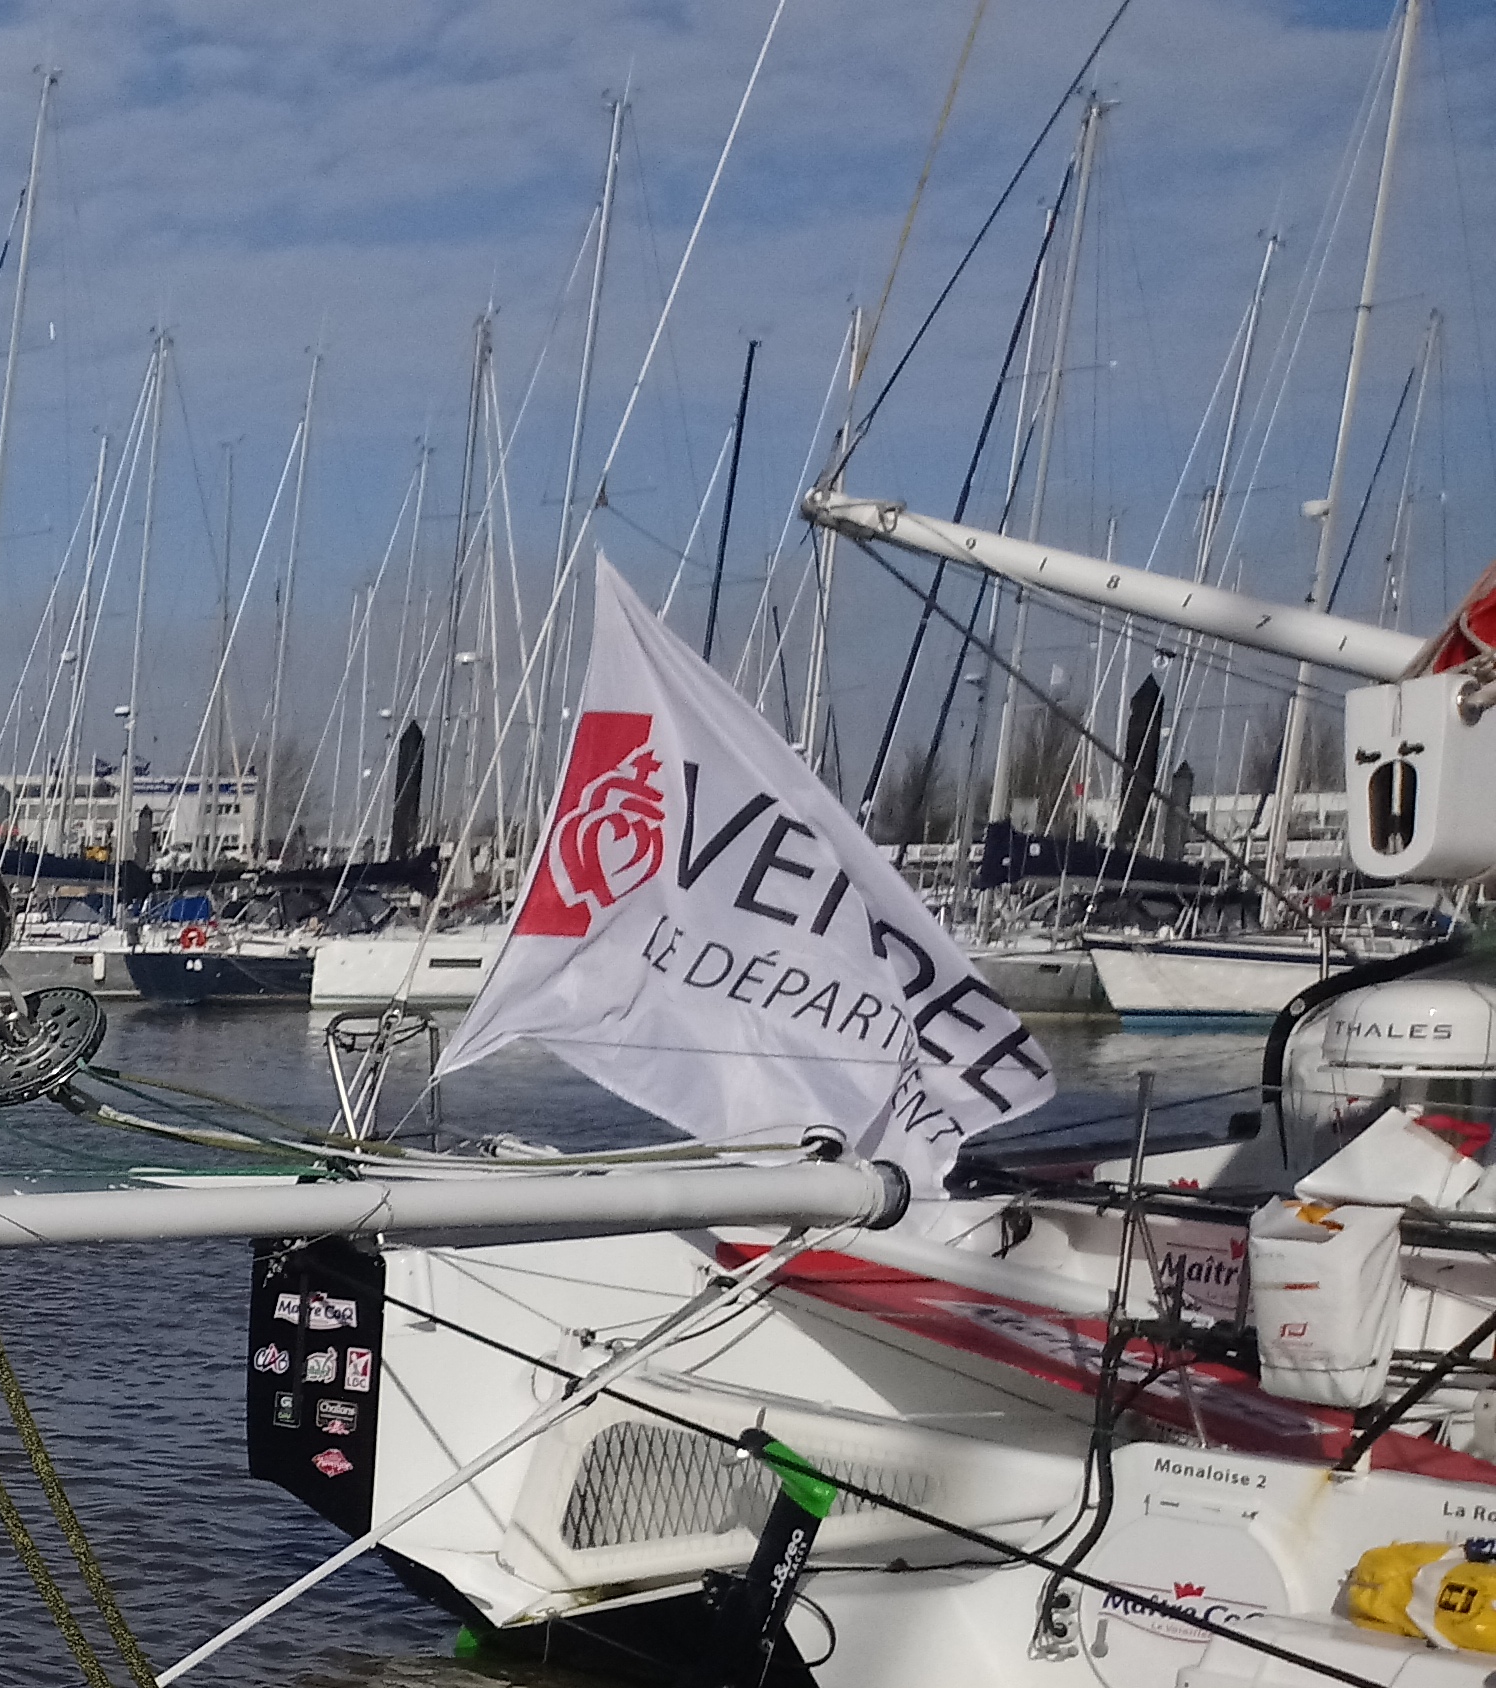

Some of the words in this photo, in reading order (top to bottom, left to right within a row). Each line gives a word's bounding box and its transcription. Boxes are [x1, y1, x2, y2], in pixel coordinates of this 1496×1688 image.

[642, 914, 685, 974] LE
[1335, 1019, 1453, 1040] THALES
[1160, 1251, 1240, 1287] Maîtr
[1154, 1457, 1251, 1487] Monaloise
[1255, 1474, 1268, 1489] 2
[1443, 1500, 1466, 1518] La
